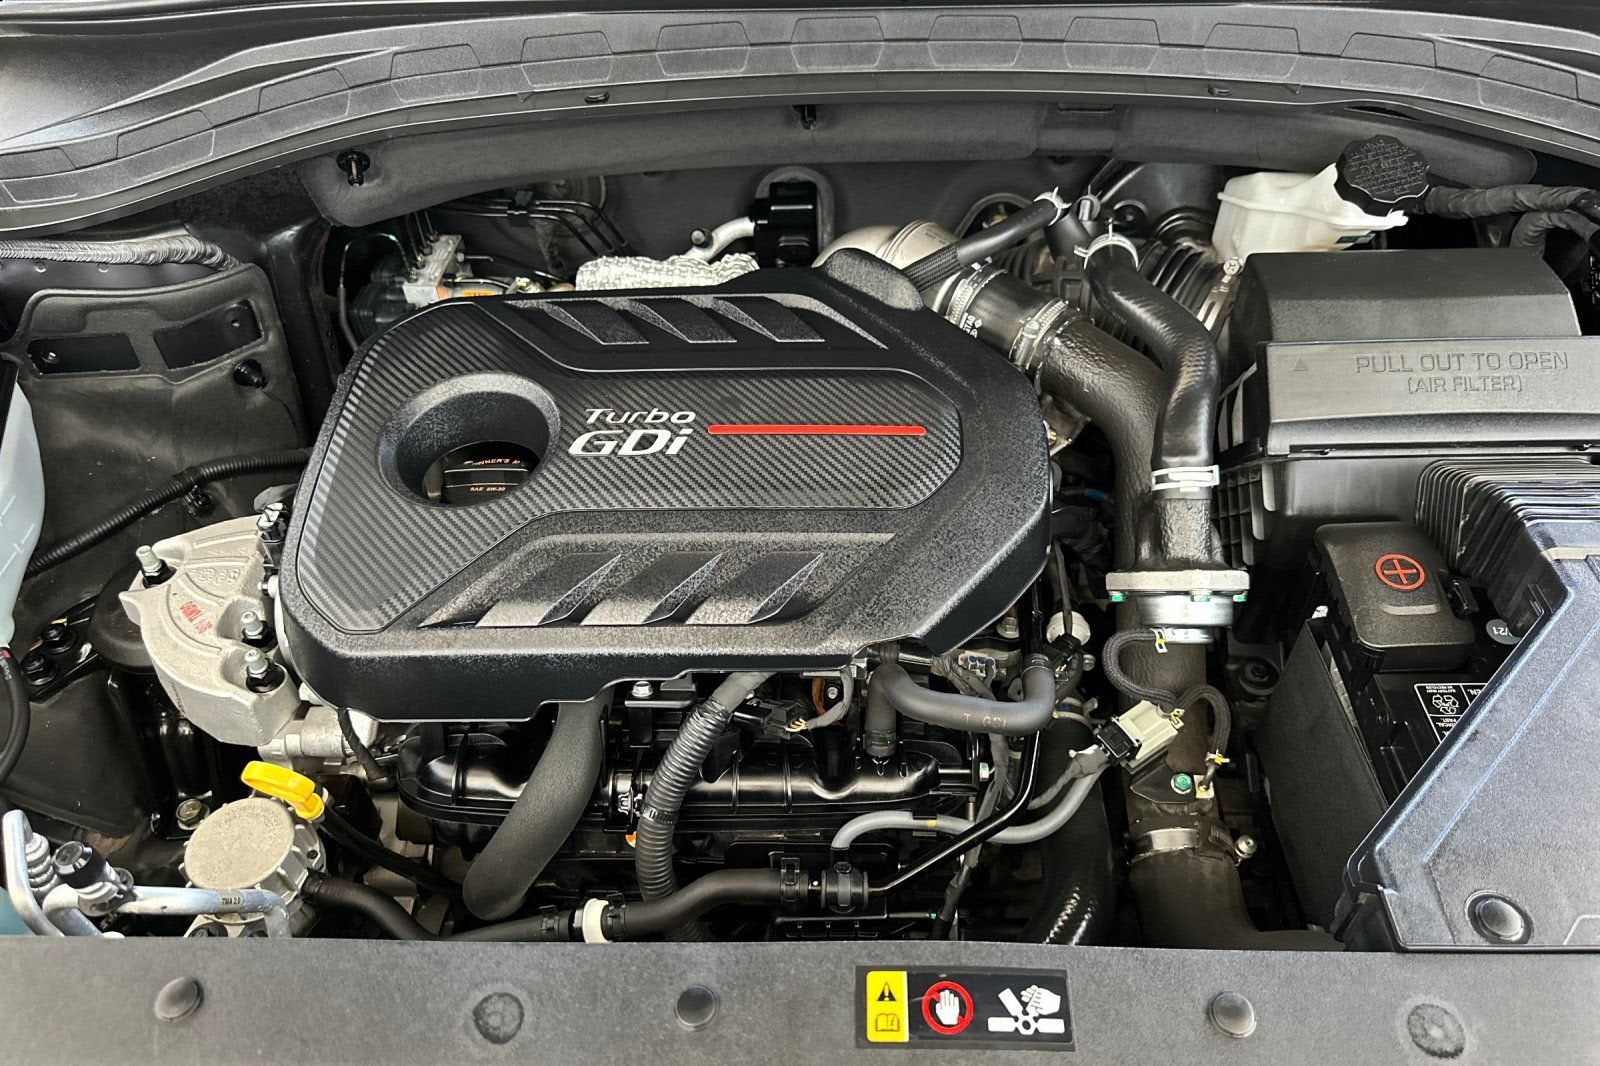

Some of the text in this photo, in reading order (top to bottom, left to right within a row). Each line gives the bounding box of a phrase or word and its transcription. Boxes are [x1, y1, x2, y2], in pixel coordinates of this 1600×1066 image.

[1355, 351, 1569, 373] PULL OUT TO OPEN
[1453, 375, 1523, 392] FILTER)
[586, 408, 697, 424] Turbo
[568, 428, 694, 456] GDi
[1492, 626, 1512, 637] /21
[963, 713, 971, 723] T
